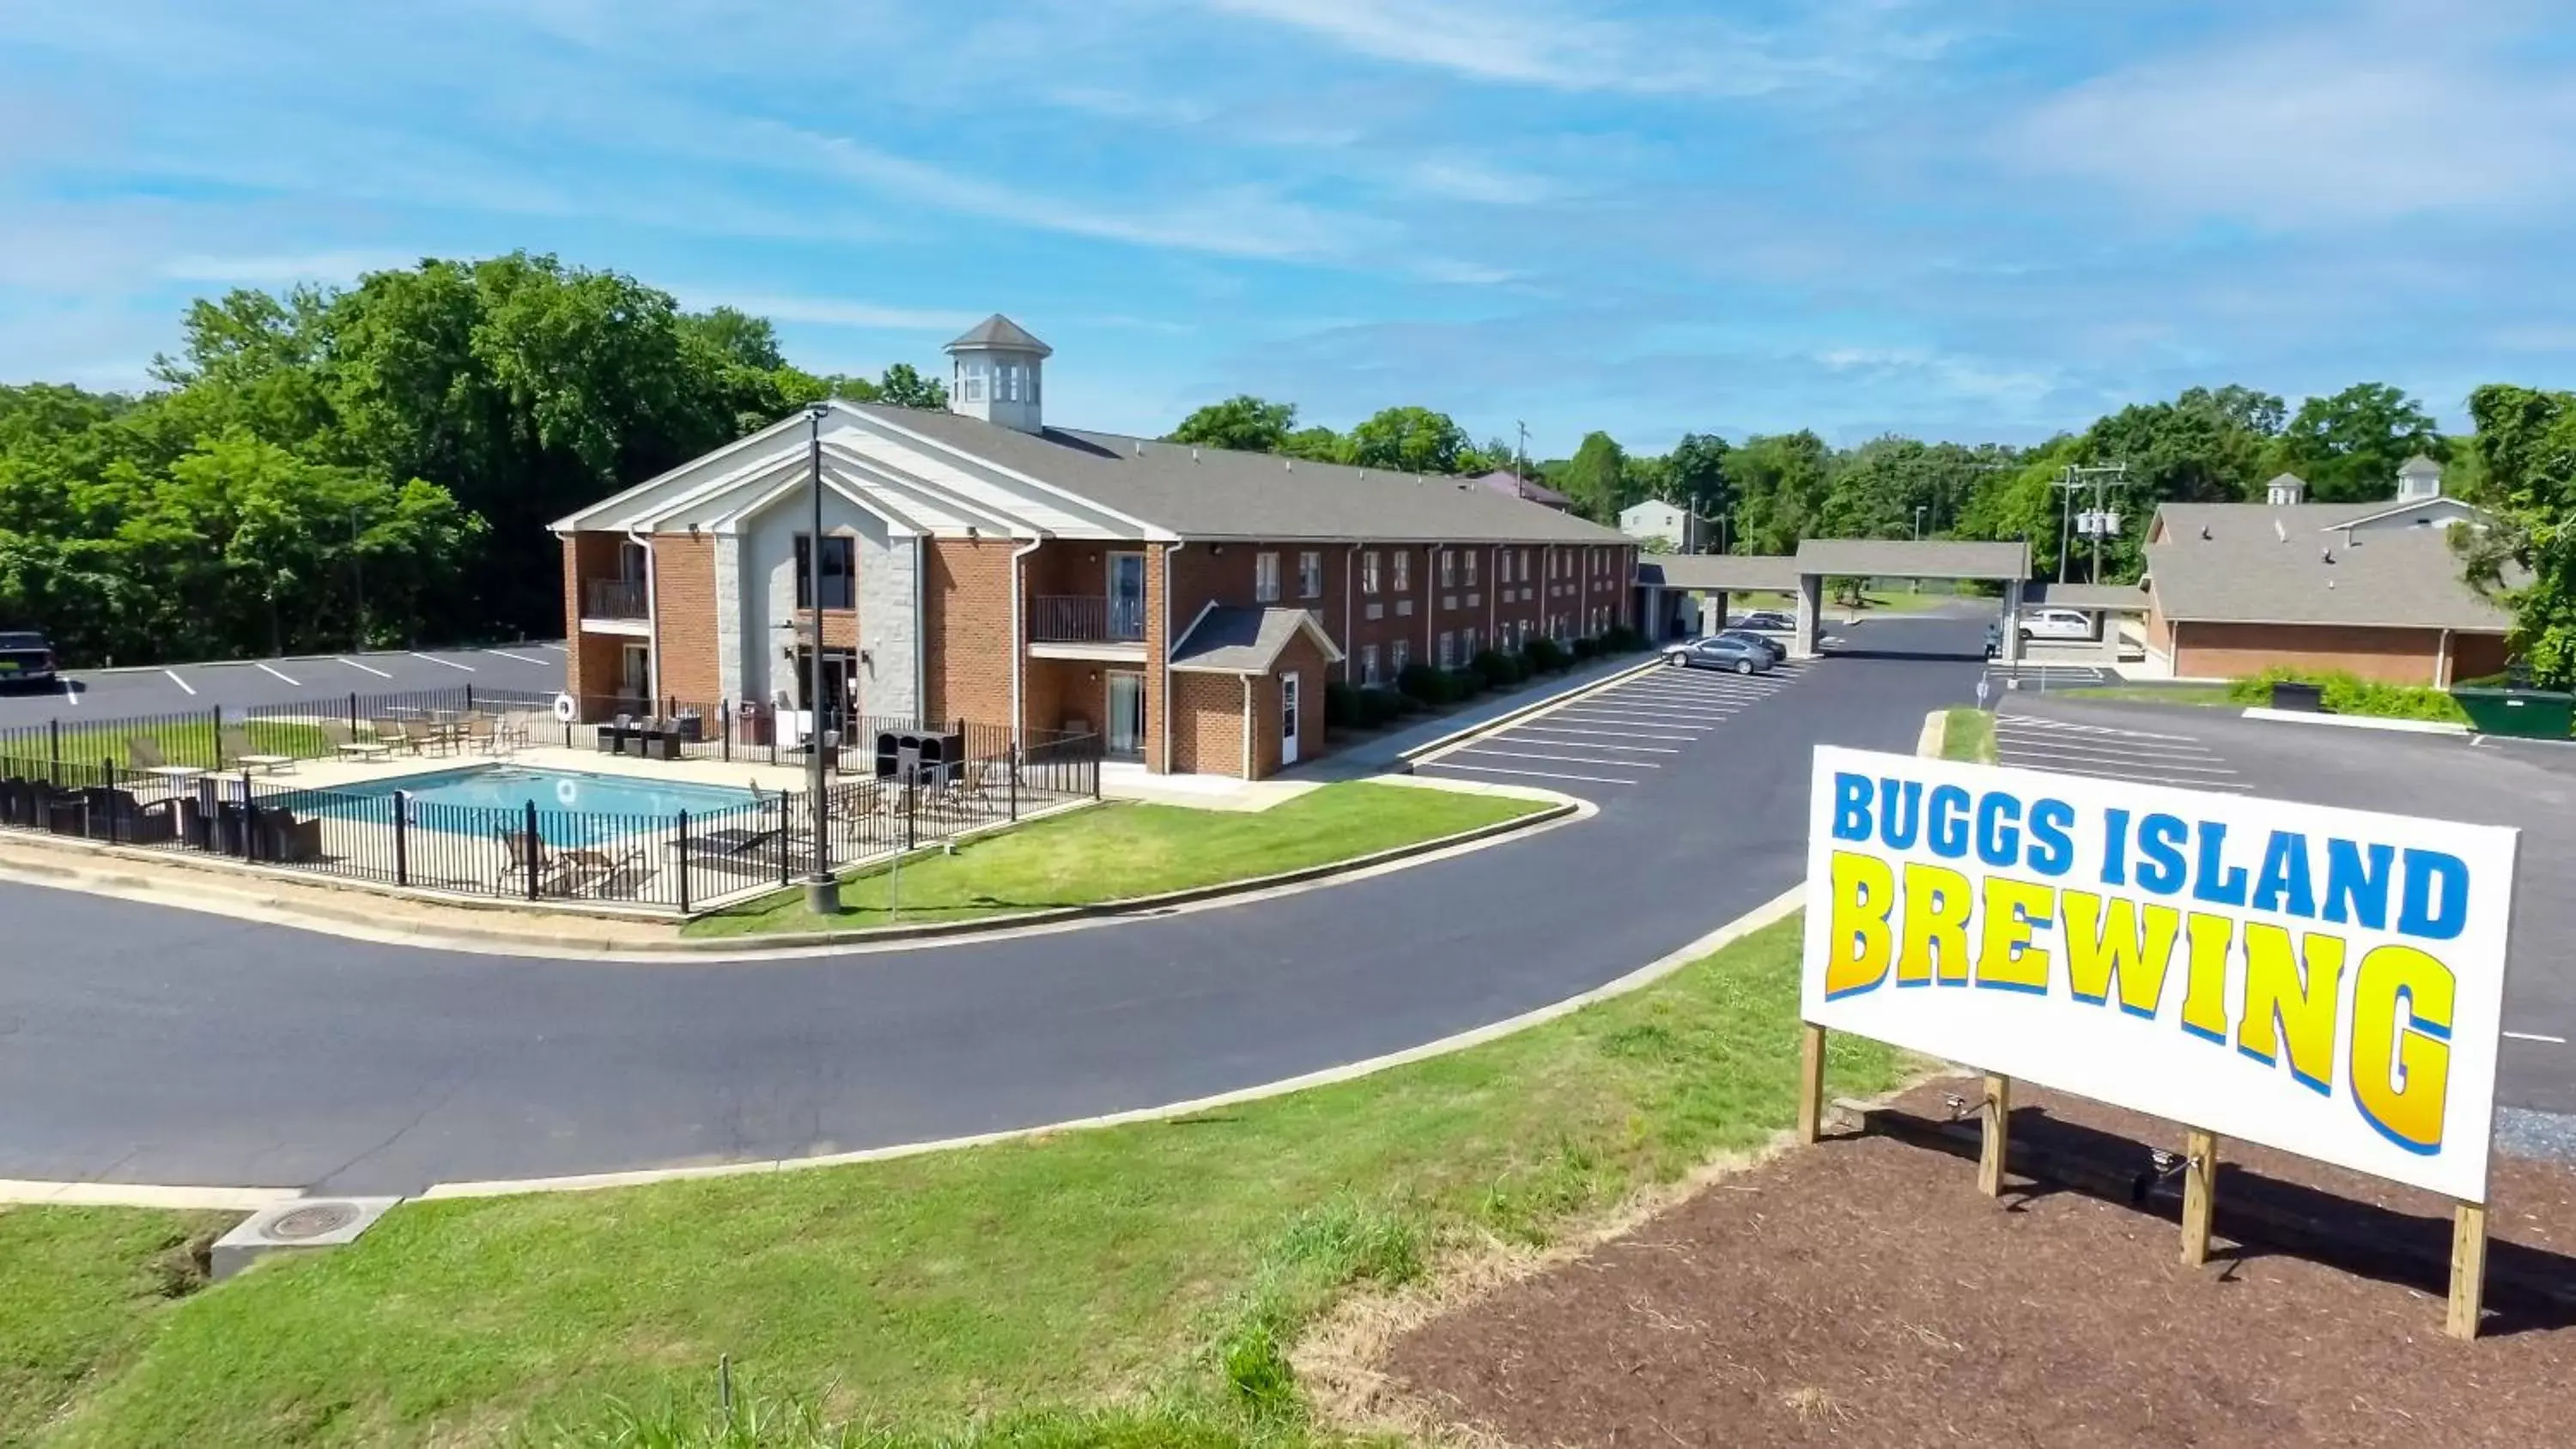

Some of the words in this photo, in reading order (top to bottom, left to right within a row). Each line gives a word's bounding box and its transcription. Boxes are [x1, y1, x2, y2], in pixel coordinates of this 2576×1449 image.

[1832, 773, 2075, 876] BUGGS
[2101, 809, 2470, 940] ISLAND
[1825, 851, 2456, 1155] BREWING
